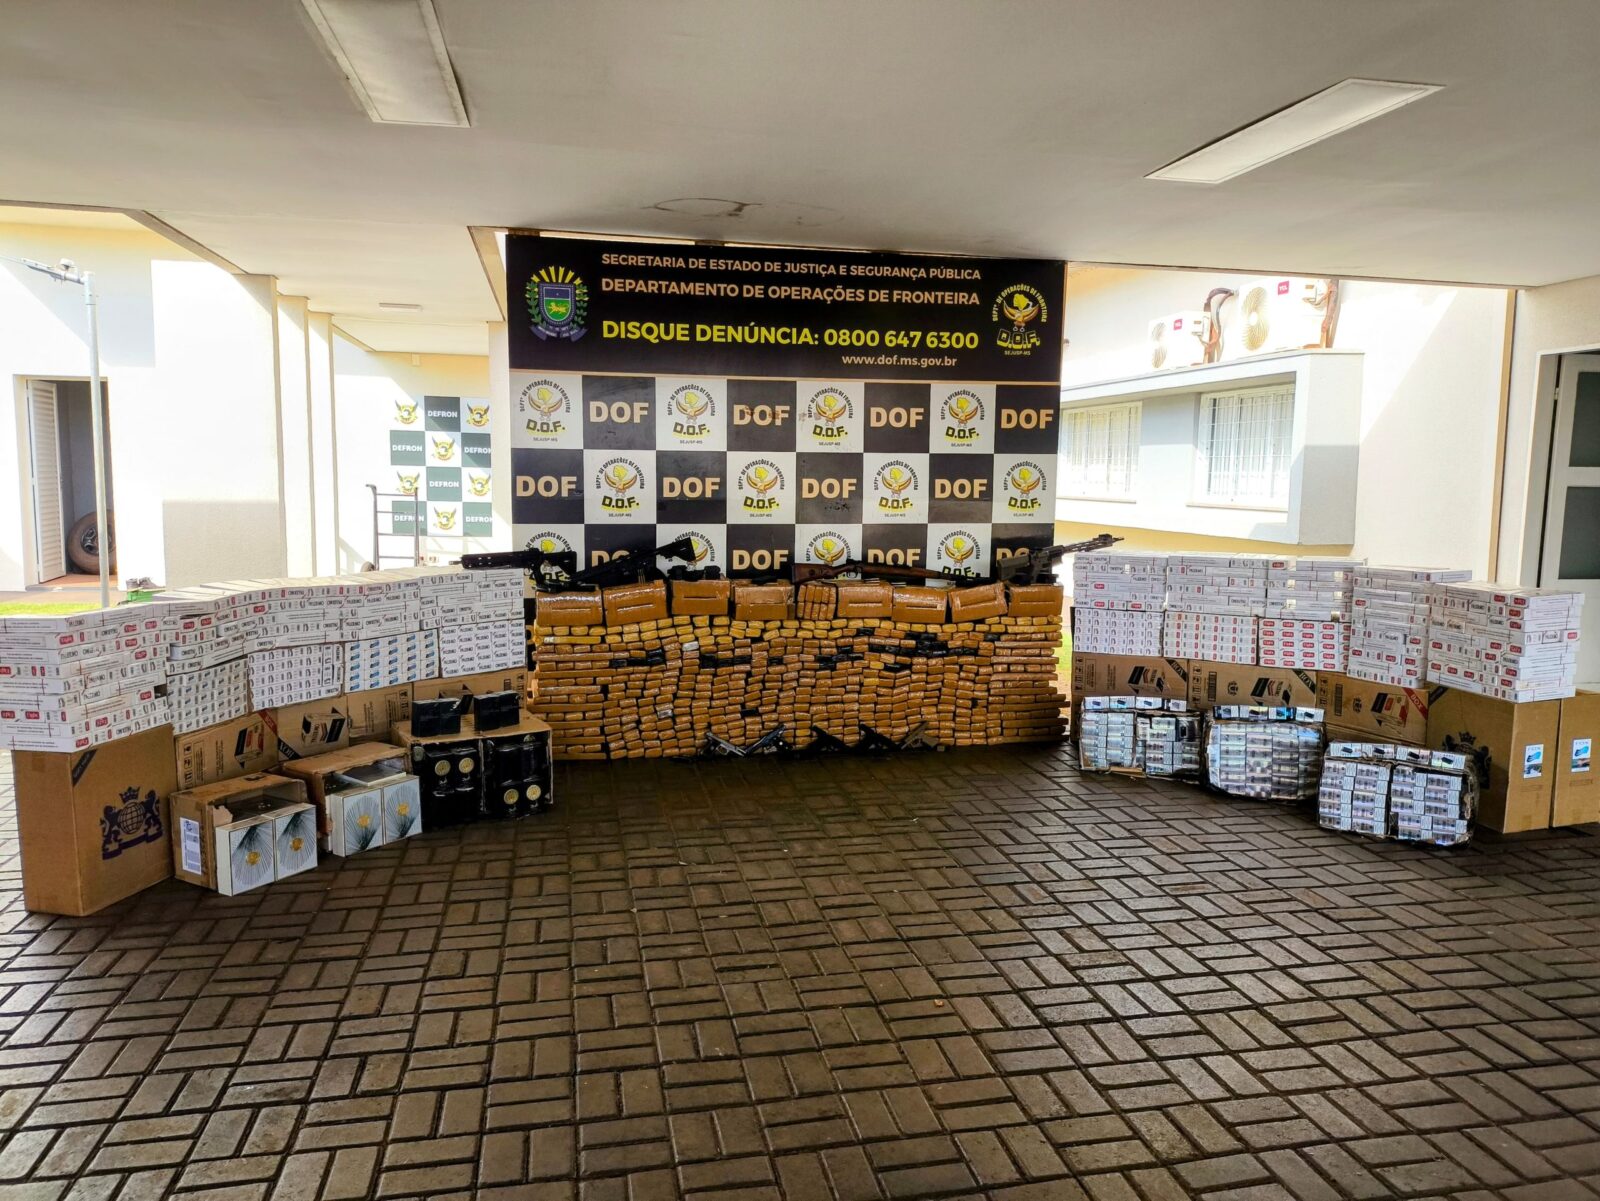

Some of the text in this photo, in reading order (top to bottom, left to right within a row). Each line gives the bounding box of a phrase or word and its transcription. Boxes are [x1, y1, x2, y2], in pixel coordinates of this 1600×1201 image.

[602, 253, 981, 280] SECRETARIA DE ESTADO DE JUSTIÇA E SEGURANÇA PÚBLICA
[602, 278, 980, 305] DEPARTAMENTO DE OPERAÇÕES DE FRONTEIRA
[603, 320, 978, 348] DISQUE DENÚNCIA: 0800 647 6300
[842, 354, 957, 368] www.dof.ms.gov.br
[590, 401, 649, 423] DOF
[733, 405, 790, 426] DOF
[870, 407, 924, 428] DOF
[1001, 408, 1054, 429] DOF
[526, 419, 565, 432] D.O.F.
[673, 422, 710, 435] D.O.F.
[813, 424, 848, 438] D.O.F.
[946, 426, 979, 439] D.O.F.
[516, 476, 577, 497] DOF
[663, 477, 720, 498] DOF
[802, 478, 857, 498] DOF
[935, 479, 987, 499] DOF
[602, 496, 639, 508] D.O.F.
[744, 496, 779, 509] D.O.F.
[879, 497, 913, 509] D.O.F.
[1008, 497, 1041, 509] D.O.F.
[733, 550, 788, 570] DOF
[868, 548, 920, 566] DOF
[1300, 673, 1312, 688] BOX
[1410, 694, 1422, 708] BOX
